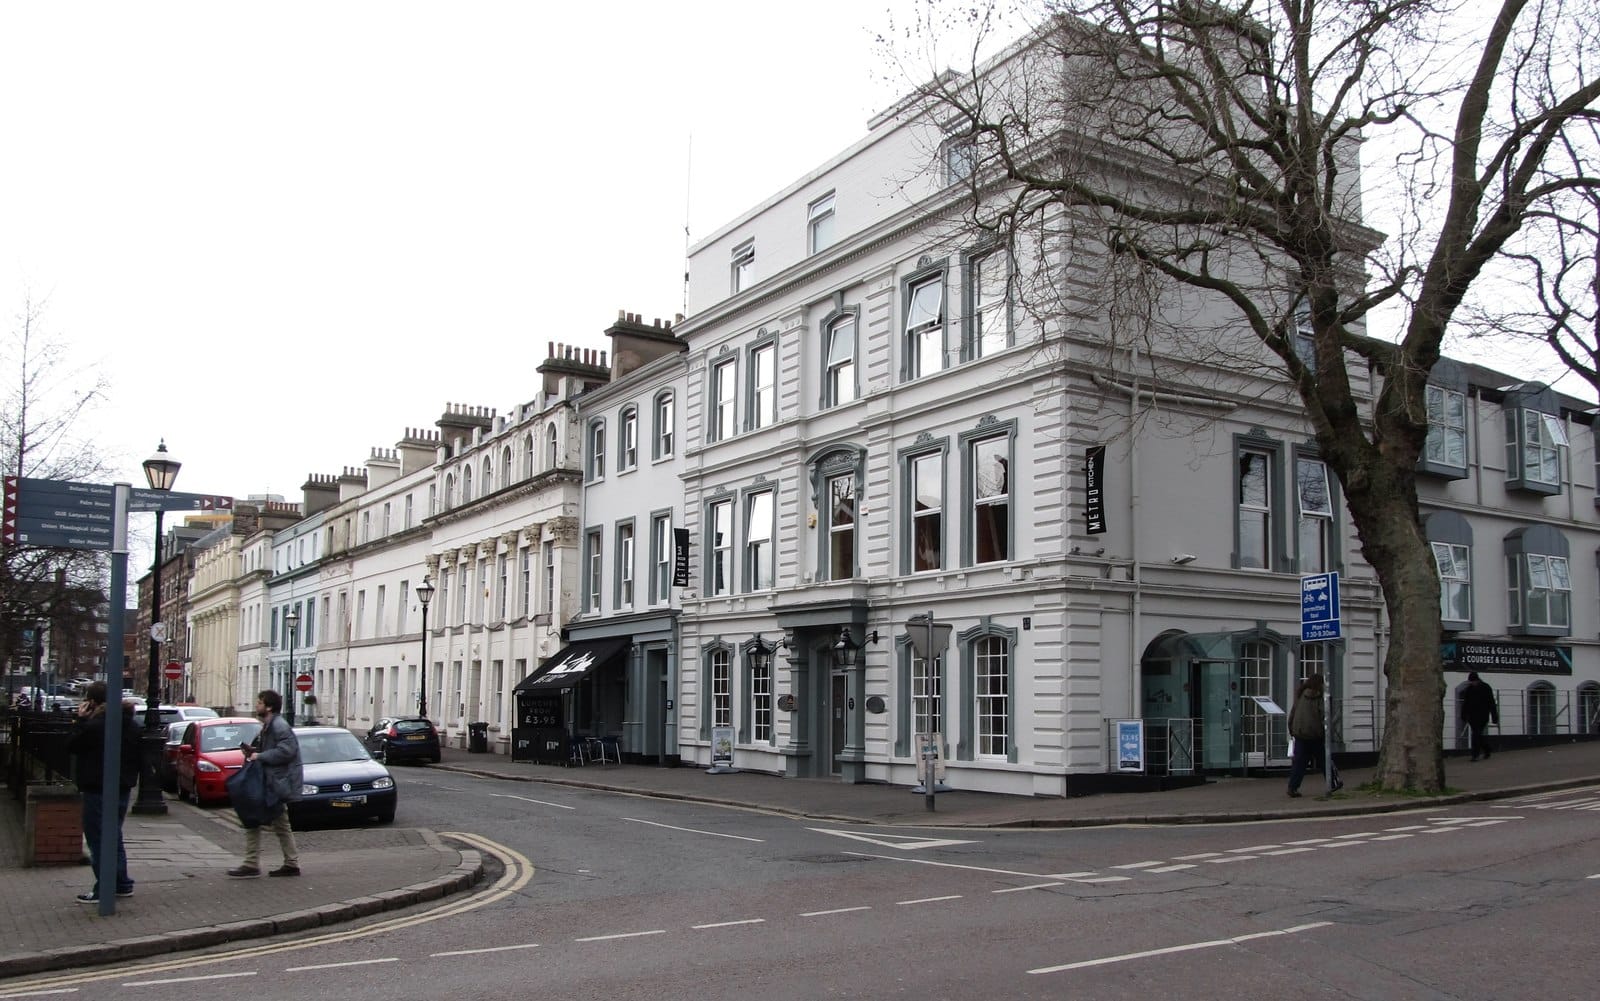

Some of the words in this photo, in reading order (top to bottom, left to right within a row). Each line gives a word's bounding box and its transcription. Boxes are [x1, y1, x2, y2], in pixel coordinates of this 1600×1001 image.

[1088, 489, 1101, 531] METRO
[1466, 646, 1489, 654] COURSE
[1497, 647, 1515, 655] GLASS
[1516, 647, 1525, 656] OF
[1466, 655, 1494, 664] COURSES
[1501, 657, 1519, 665] GLASS
[1520, 657, 1528, 665] OF
[1529, 658, 1543, 666] WINE
[525, 715, 556, 725] £3.95
